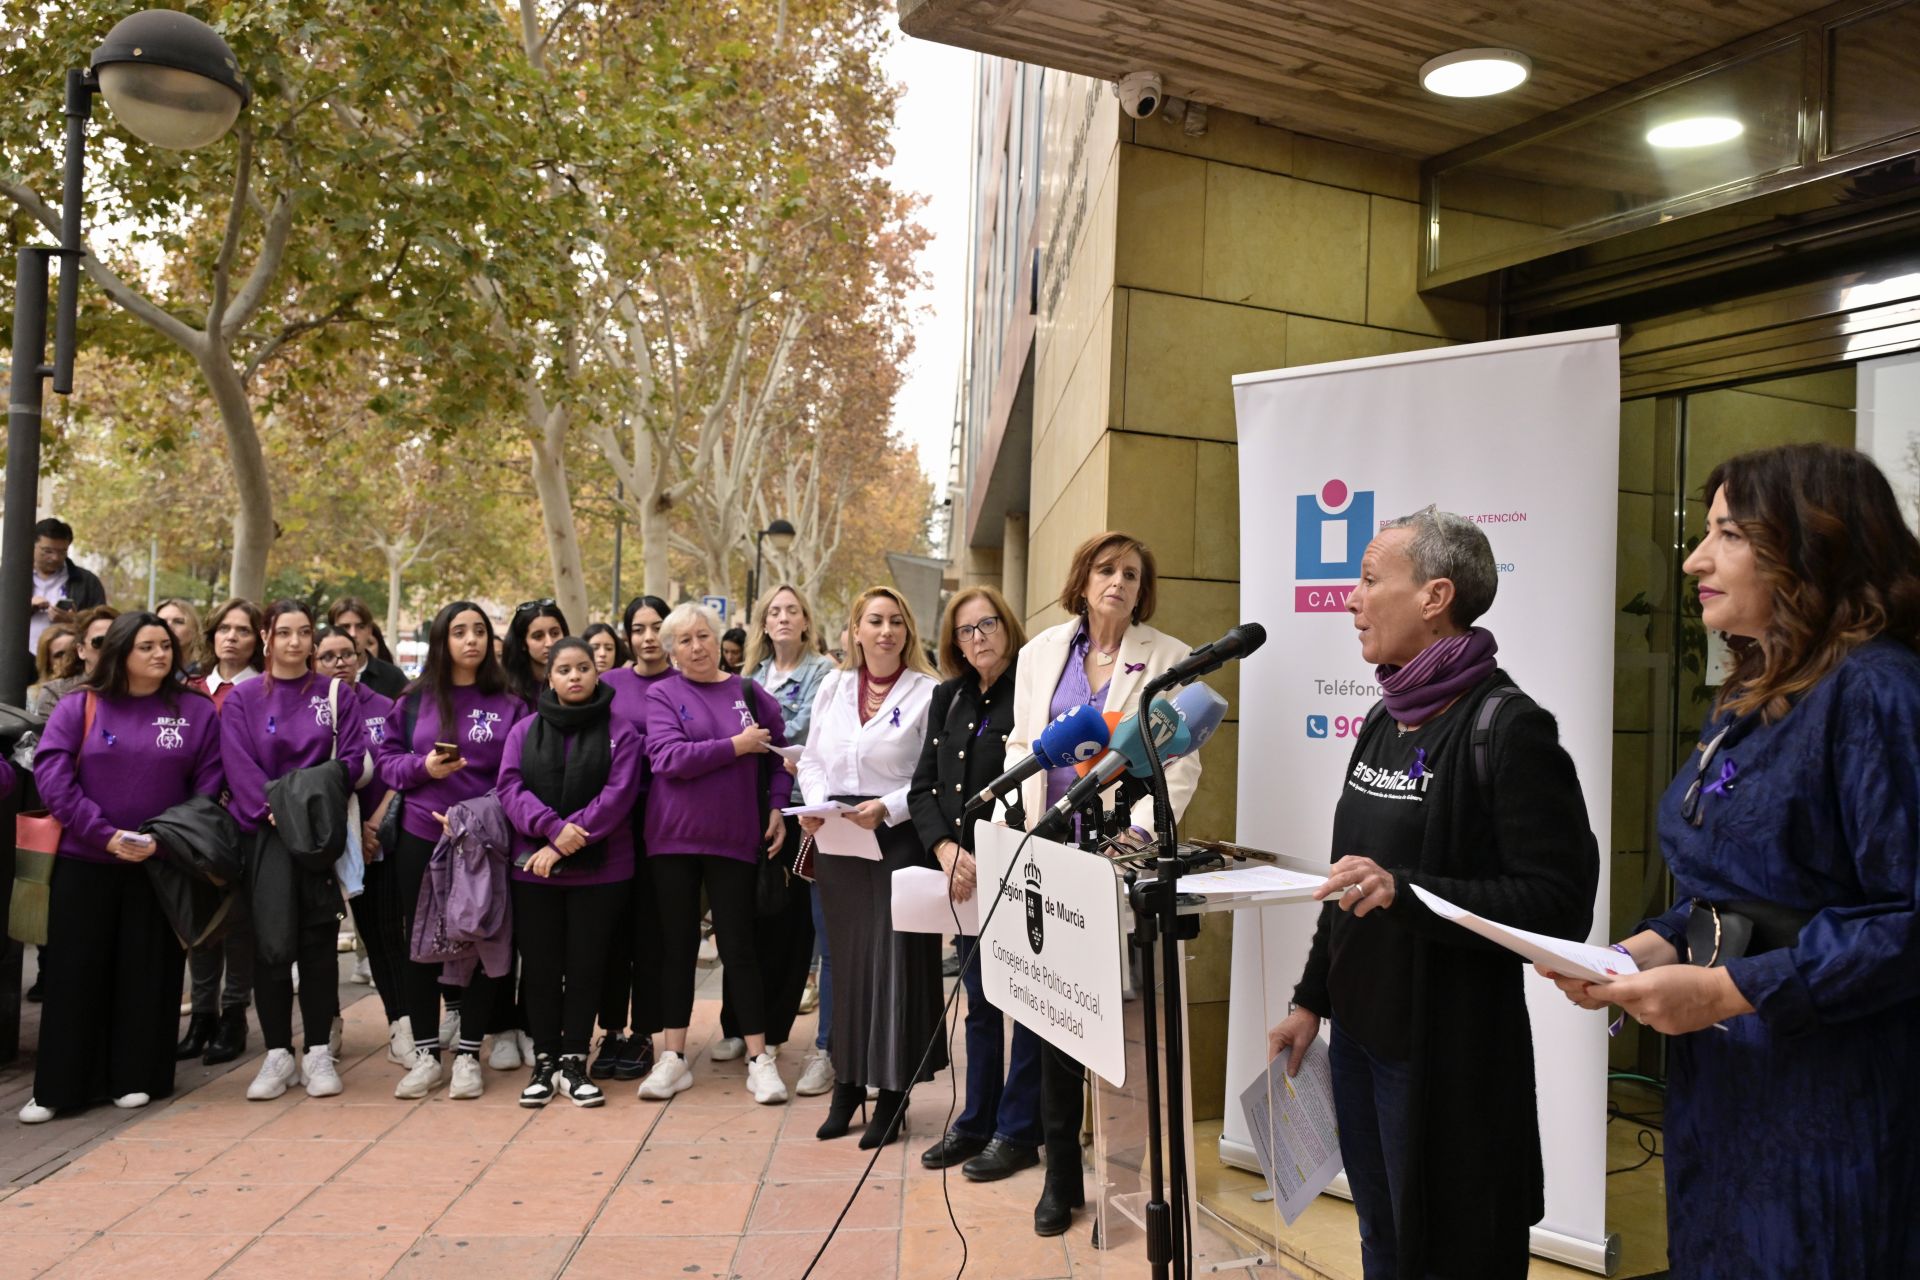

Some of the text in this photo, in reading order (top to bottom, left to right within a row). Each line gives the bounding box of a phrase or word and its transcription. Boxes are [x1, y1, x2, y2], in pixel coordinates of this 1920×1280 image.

[1476, 511, 1527, 524] ATENCIÓN
[1314, 679, 1384, 697] Teléfono
[1149, 713, 1173, 748] TV
[1045, 896, 1055, 916] de
[1057, 901, 1085, 929] Murcia
[1031, 960, 1041, 982] de
[1074, 983, 1103, 1021] Social,
[1009, 977, 1084, 1039] Familias e Igualdad
